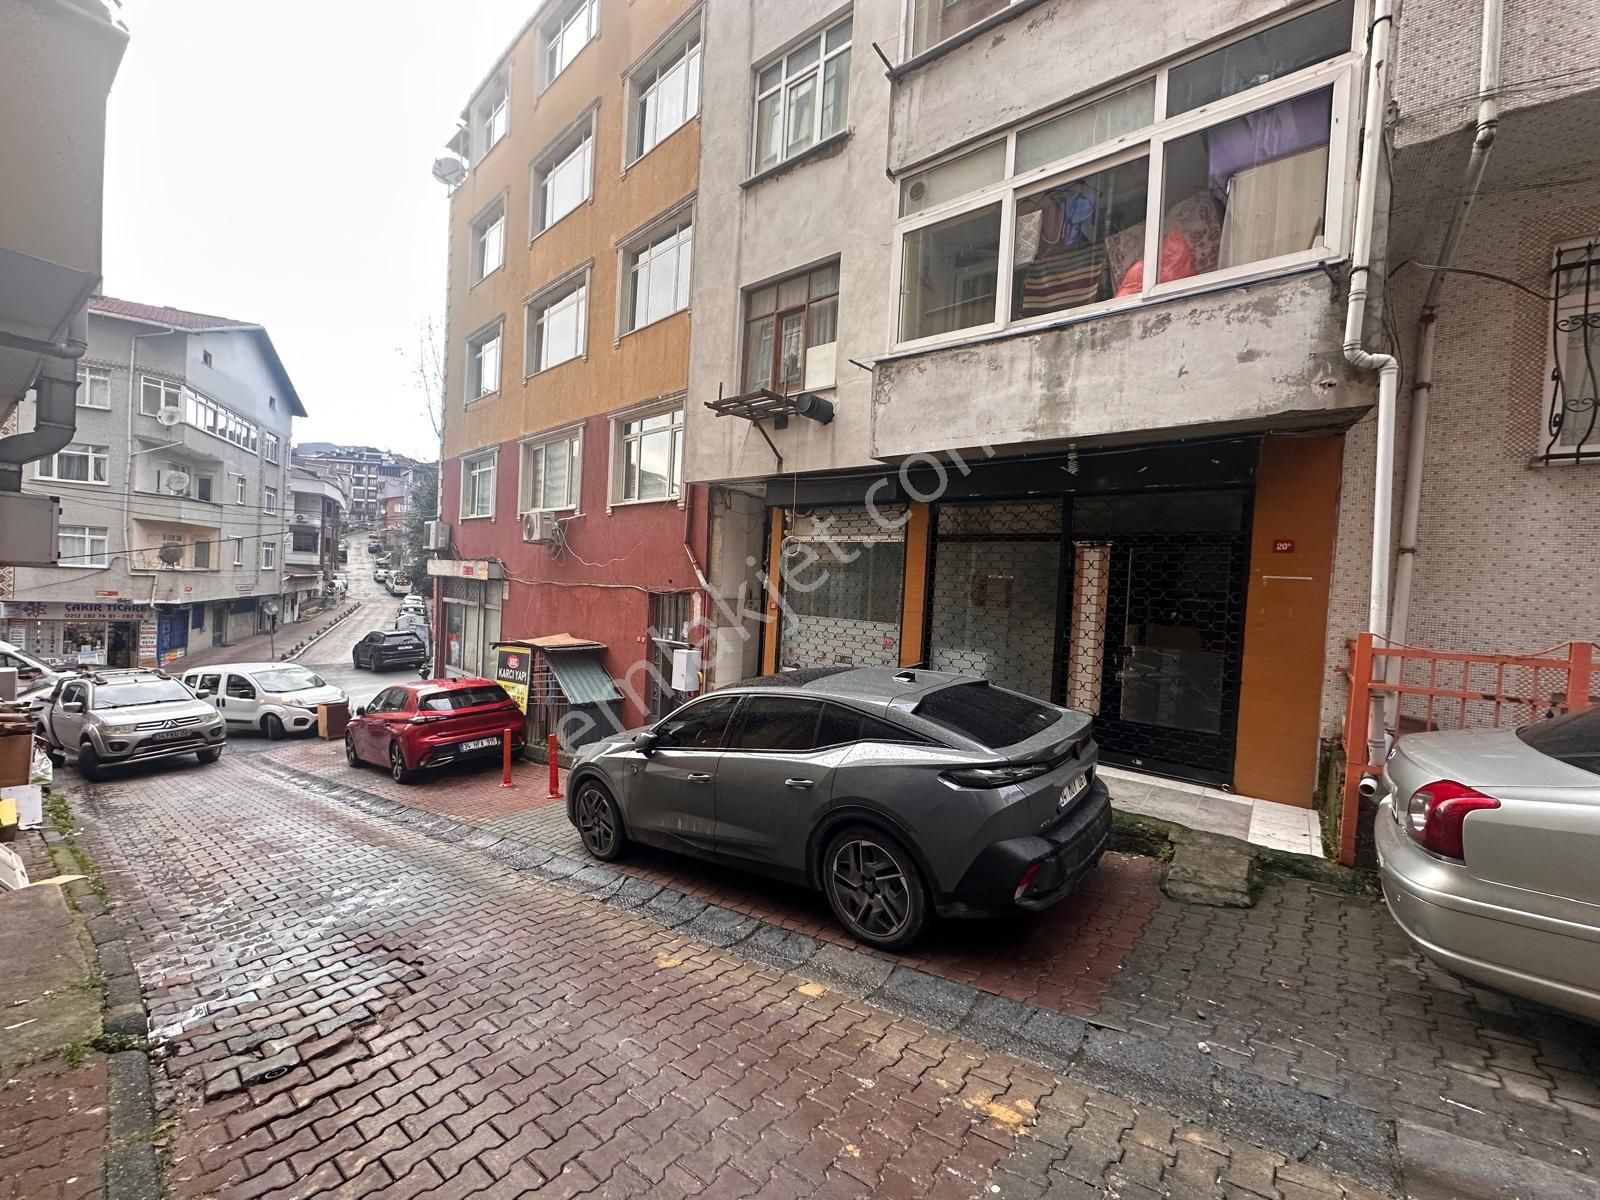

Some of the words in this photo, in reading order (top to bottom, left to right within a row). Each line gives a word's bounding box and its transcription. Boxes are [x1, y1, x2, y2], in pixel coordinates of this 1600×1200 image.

[65, 603, 102, 613] ÇAKIR
[498, 668, 515, 680] KARCI
[515, 670, 527, 682] YAPI
